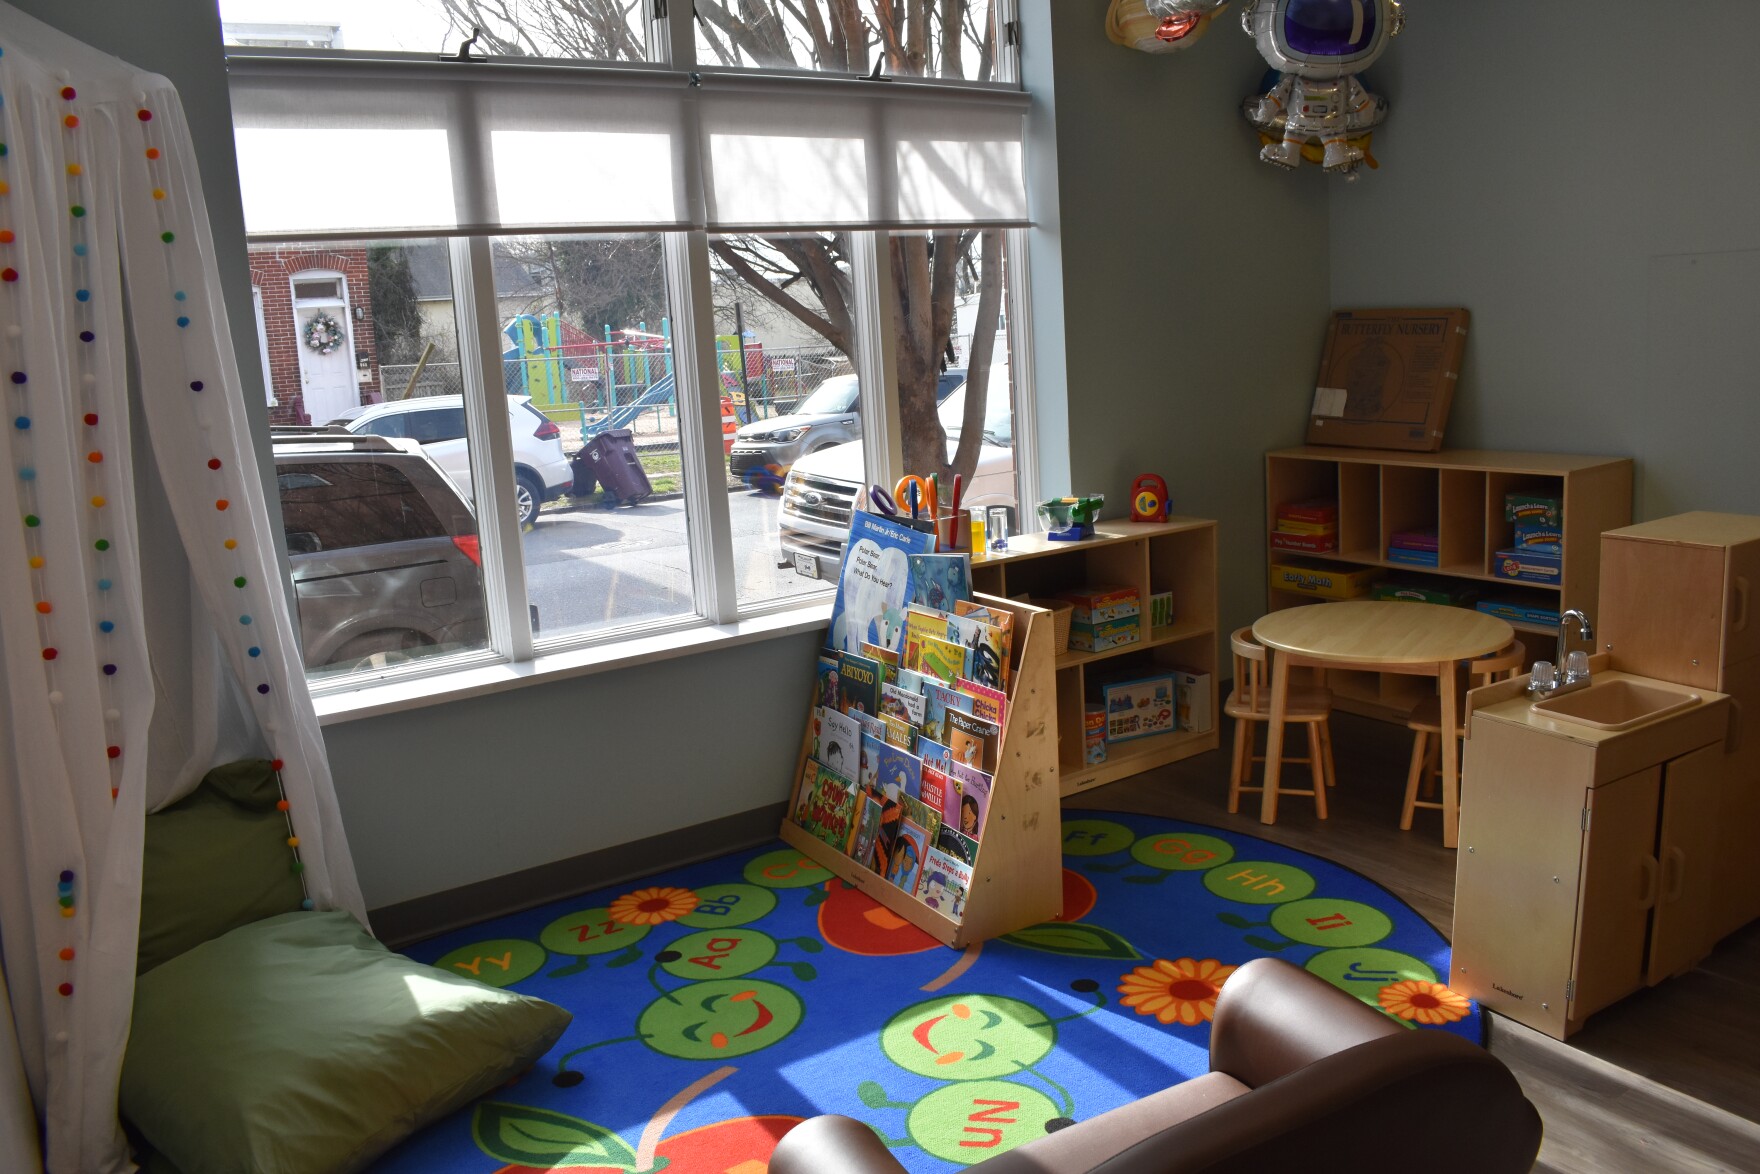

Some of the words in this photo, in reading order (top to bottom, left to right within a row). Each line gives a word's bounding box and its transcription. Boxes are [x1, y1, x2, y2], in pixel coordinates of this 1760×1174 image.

[1340, 323, 1393, 335] BUTTERFLY
[1398, 323, 1441, 335] NURSERY
[1512, 503, 1530, 513] Launch
[864, 520, 872, 529] Bill
[872, 523, 885, 534] Martin
[898, 533, 911, 544] Carle
[1522, 531, 1542, 541] Launch
[858, 545, 870, 556] Polar
[869, 549, 881, 560] Bear,
[856, 556, 867, 567] Polar
[866, 560, 878, 571] Bear,
[853, 567, 865, 577] What
[864, 571, 871, 580] Do
[871, 575, 879, 584] You
[879, 578, 893, 589] Hear?
[1283, 572, 1305, 585] Early
[1308, 575, 1332, 588] Math
[841, 663, 874, 685] ABIYOYO
[889, 687, 897, 695] Old
[935, 689, 962, 707] TACKY
[907, 700, 916, 708] had
[911, 709, 923, 718] farm
[974, 699, 997, 714] Chicka
[827, 716, 838, 732] Say
[838, 722, 852, 737] Hello
[949, 712, 958, 725] The
[958, 716, 972, 730] Paper
[971, 722, 991, 736] Crane
[887, 727, 912, 747] MALES
[924, 753, 934, 767] Not
[935, 758, 947, 774] Me!
[821, 778, 849, 806] COUNT
[1062, 829, 1109, 847] Ff
[1152, 838, 1218, 865] Gg
[761, 856, 823, 880] Cc
[929, 855, 942, 868] Freda
[942, 862, 955, 875] Stops
[958, 870, 970, 885] Bully
[1225, 868, 1287, 897] Hh
[693, 893, 741, 916] Bb
[567, 919, 626, 943] Zz
[1305, 912, 1353, 932] Ii
[454, 950, 513, 977] Yy
[687, 936, 743, 971] Aa
[1342, 961, 1400, 983] Jj
[1492, 982, 1524, 1000] Lakeshore
[959, 1098, 1020, 1149] Nn
